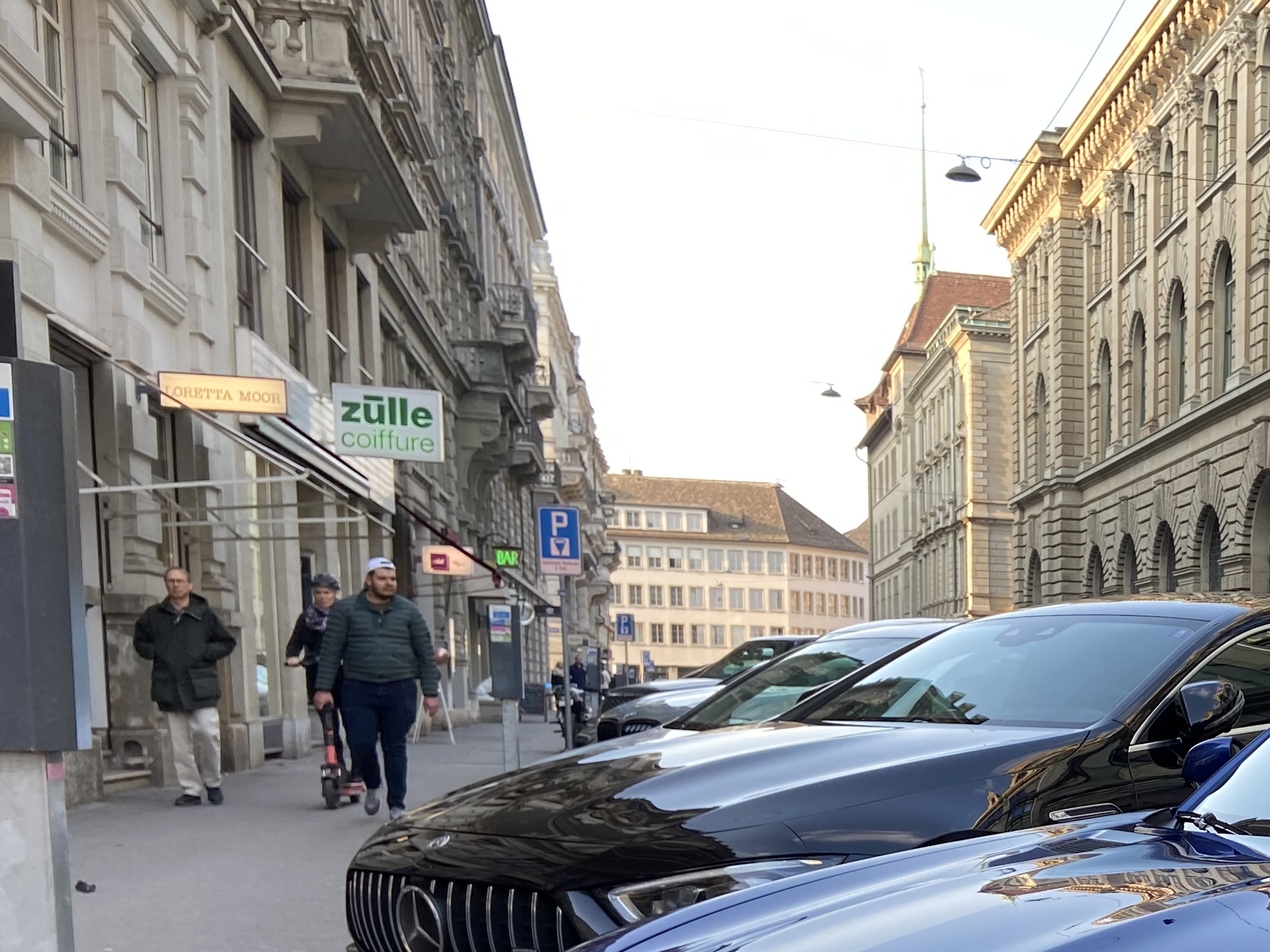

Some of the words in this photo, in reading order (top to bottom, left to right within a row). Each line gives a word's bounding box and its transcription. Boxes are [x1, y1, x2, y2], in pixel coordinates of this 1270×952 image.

[164, 385, 234, 401] LORETTA
[238, 389, 282, 404] MOOR
[341, 428, 435, 453] coiffure
[551, 511, 569, 537] P
[496, 549, 519, 566] BAR
